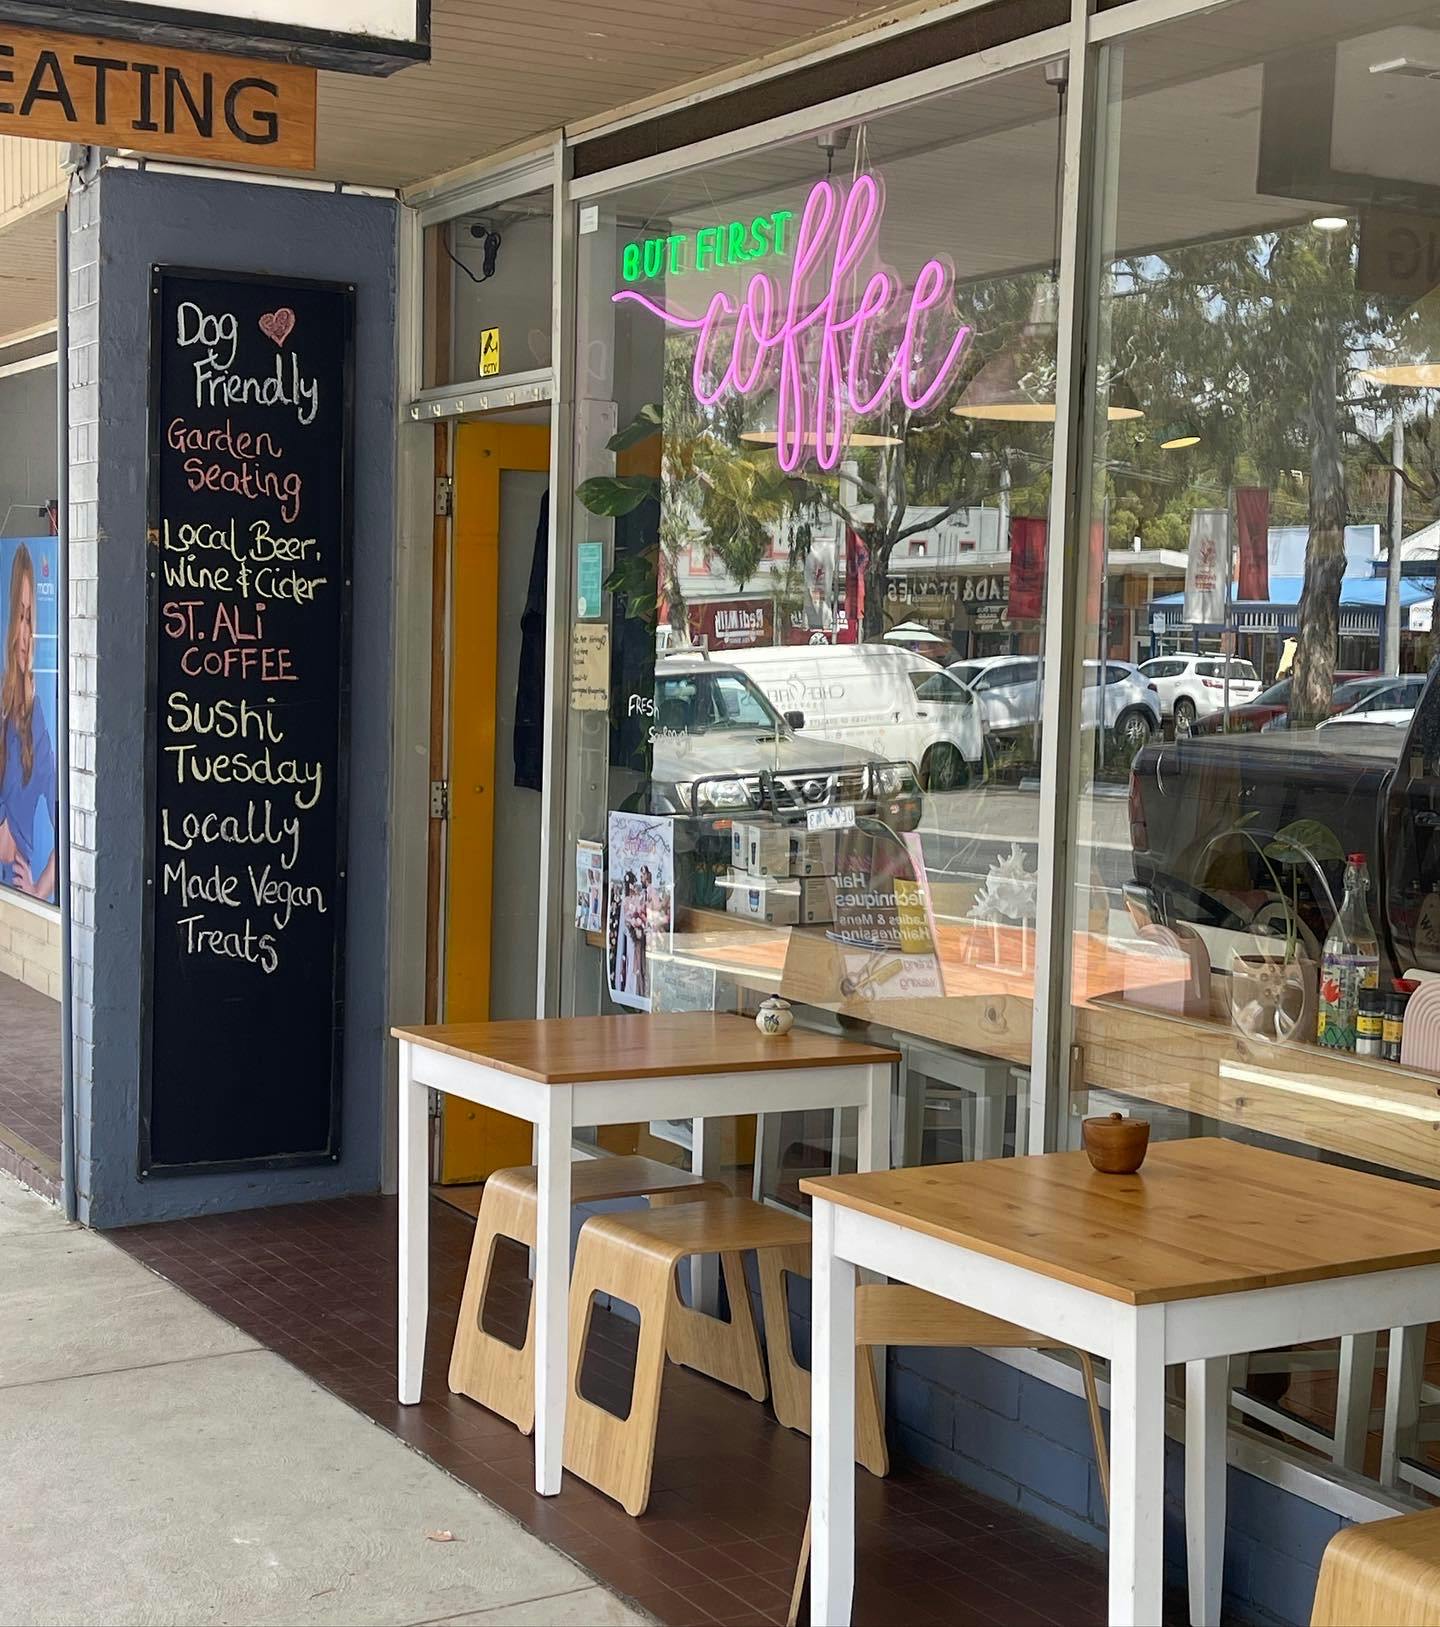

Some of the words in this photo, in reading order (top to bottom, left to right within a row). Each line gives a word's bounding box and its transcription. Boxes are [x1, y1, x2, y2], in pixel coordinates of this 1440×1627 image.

[622, 234, 686, 282] BUT
[696, 210, 794, 272] FIRST
[177, 301, 238, 371] Dog
[612, 174, 971, 473] coffee
[193, 351, 318, 425] Friendly
[483, 362, 498, 374] CCTV
[167, 418, 282, 459] Garden
[183, 458, 302, 523] Seating
[163, 518, 247, 562] Local
[164, 554, 234, 592] Wine
[236, 561, 253, 598] &
[255, 567, 328, 605] Cider
[163, 601, 205, 641] ST.
[180, 647, 299, 681] COFFEE
[167, 691, 283, 743] Sushi
[164, 744, 322, 809] Tuesday
[162, 800, 300, 870] Locally
[164, 859, 241, 908] Made
[248, 864, 327, 930] Vegan
[177, 914, 279, 974] Treats
